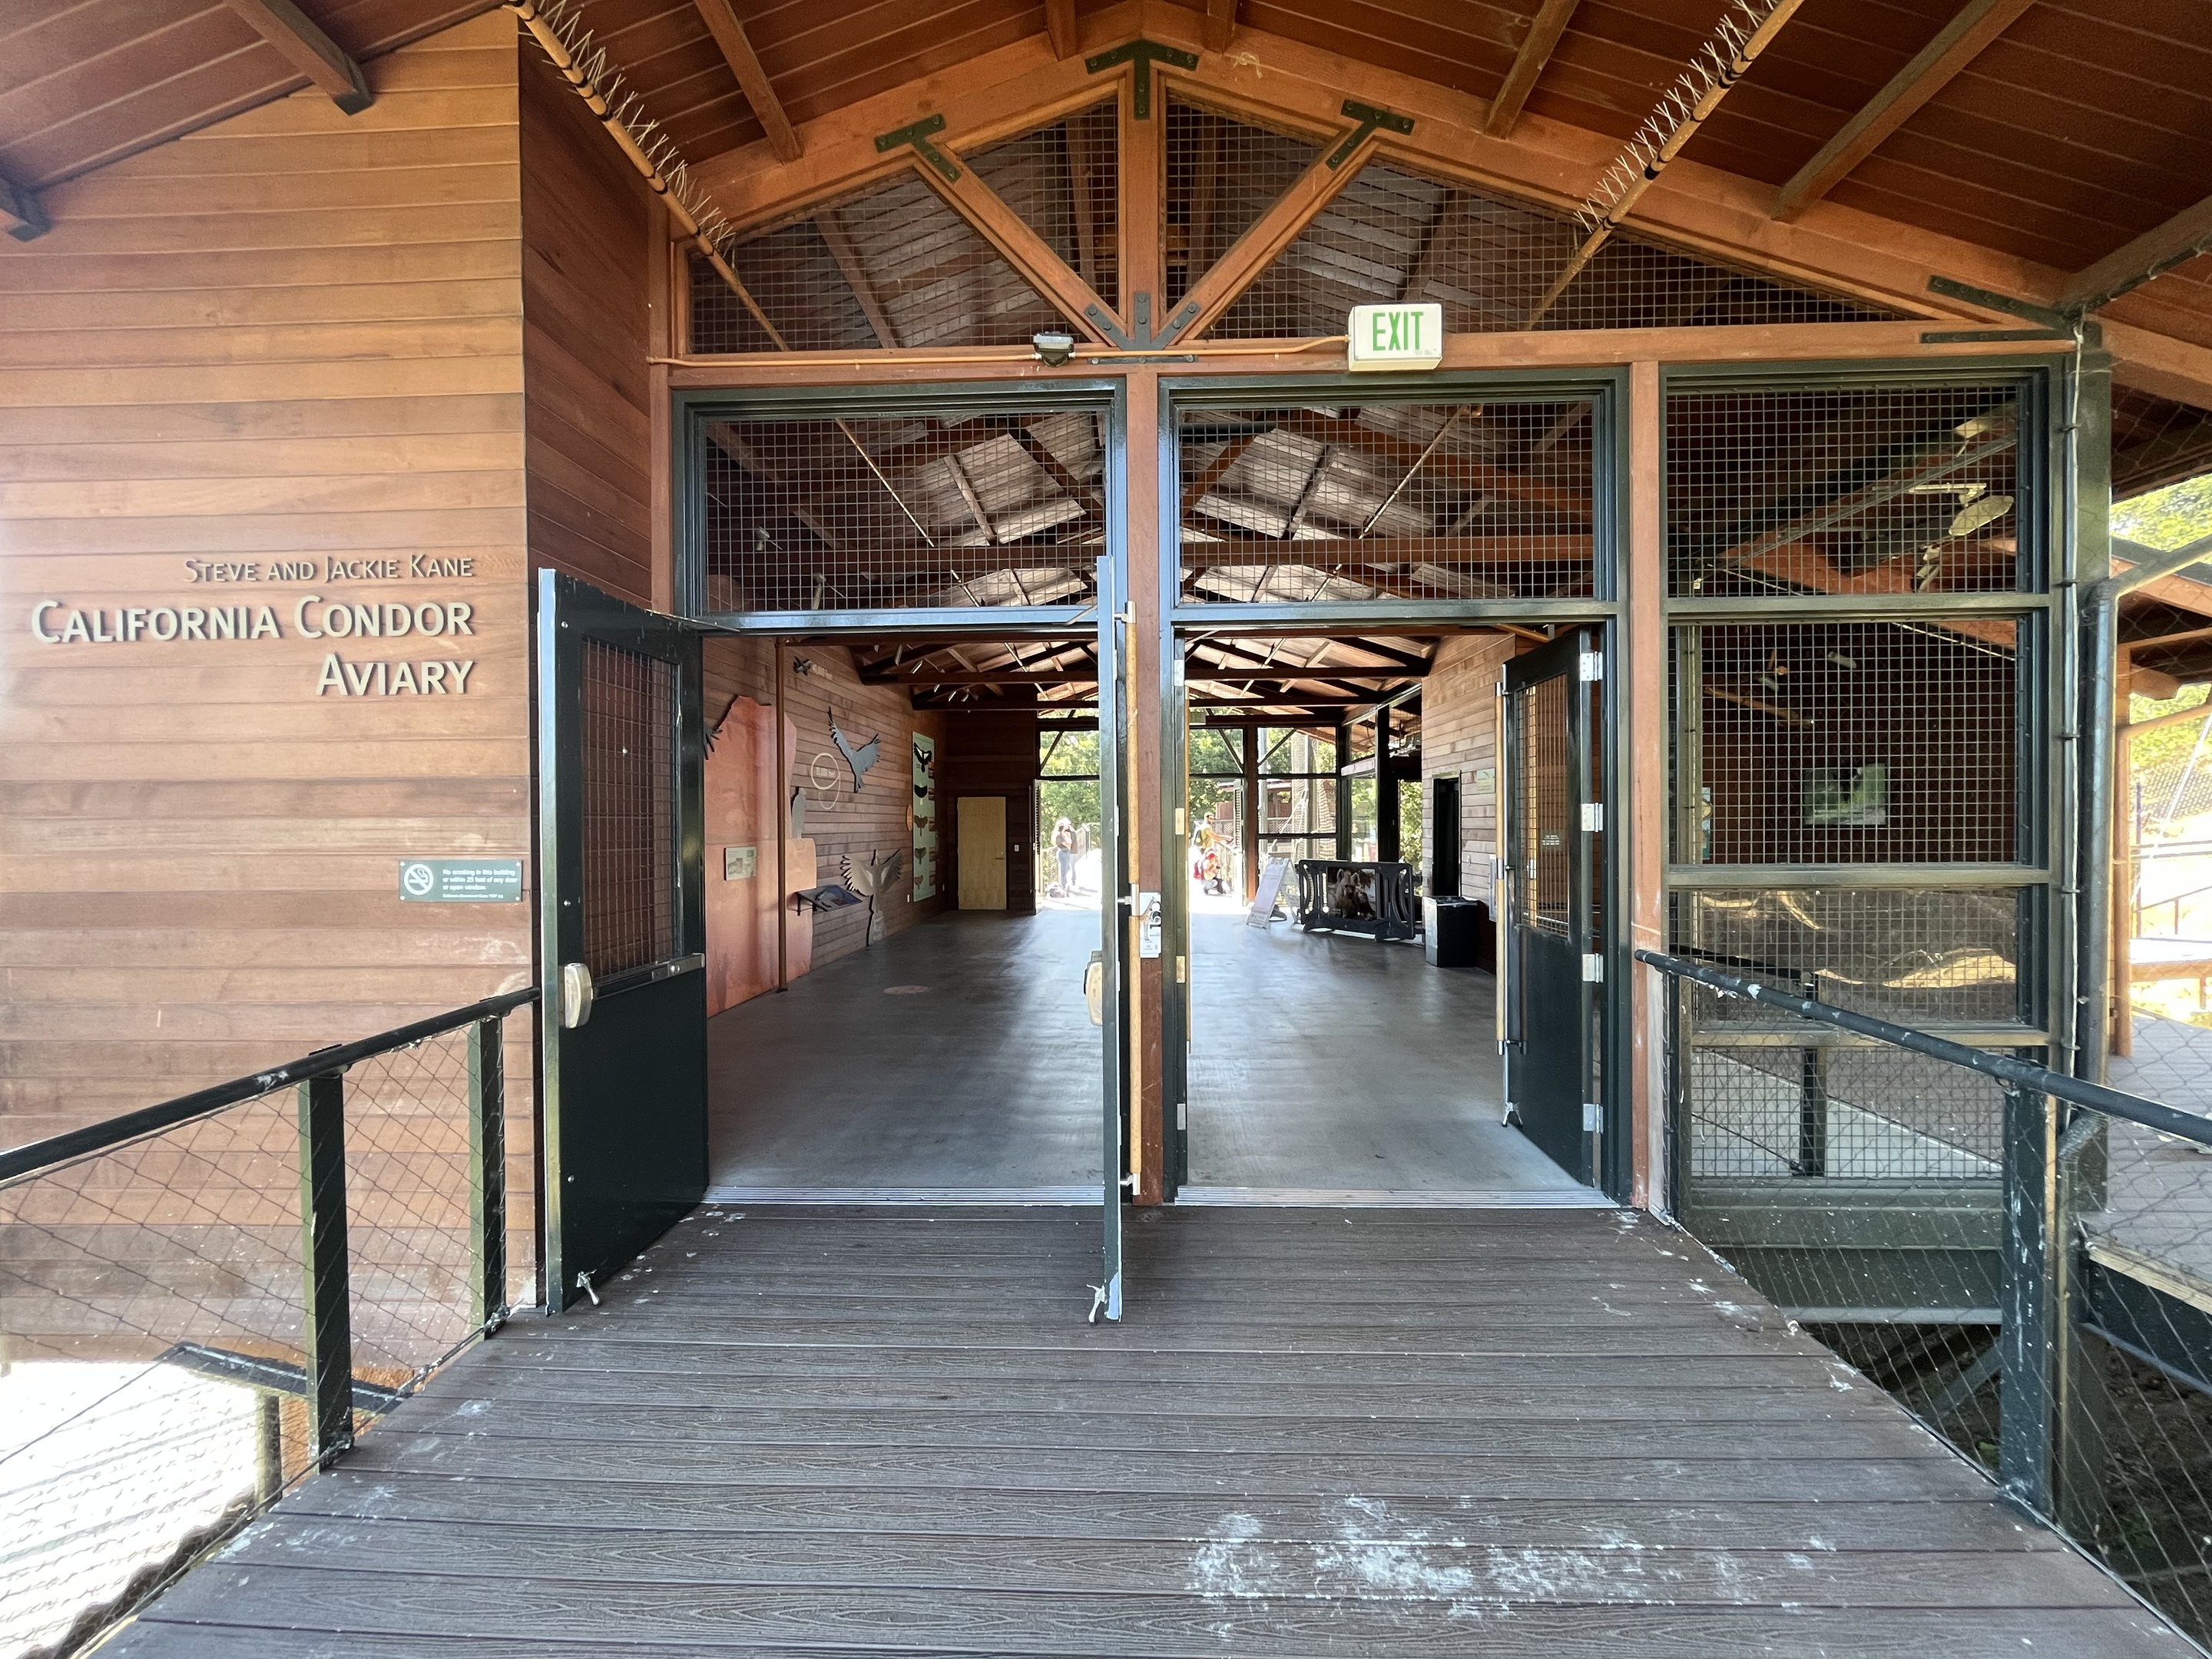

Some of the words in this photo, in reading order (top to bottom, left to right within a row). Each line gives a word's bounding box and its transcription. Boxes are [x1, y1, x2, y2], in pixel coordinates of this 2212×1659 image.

[1373, 311, 1424, 351] EXIT
[31, 599, 282, 644] CALIFORNIA
[294, 594, 474, 639] CONDOR
[316, 653, 475, 697] AVIARY
